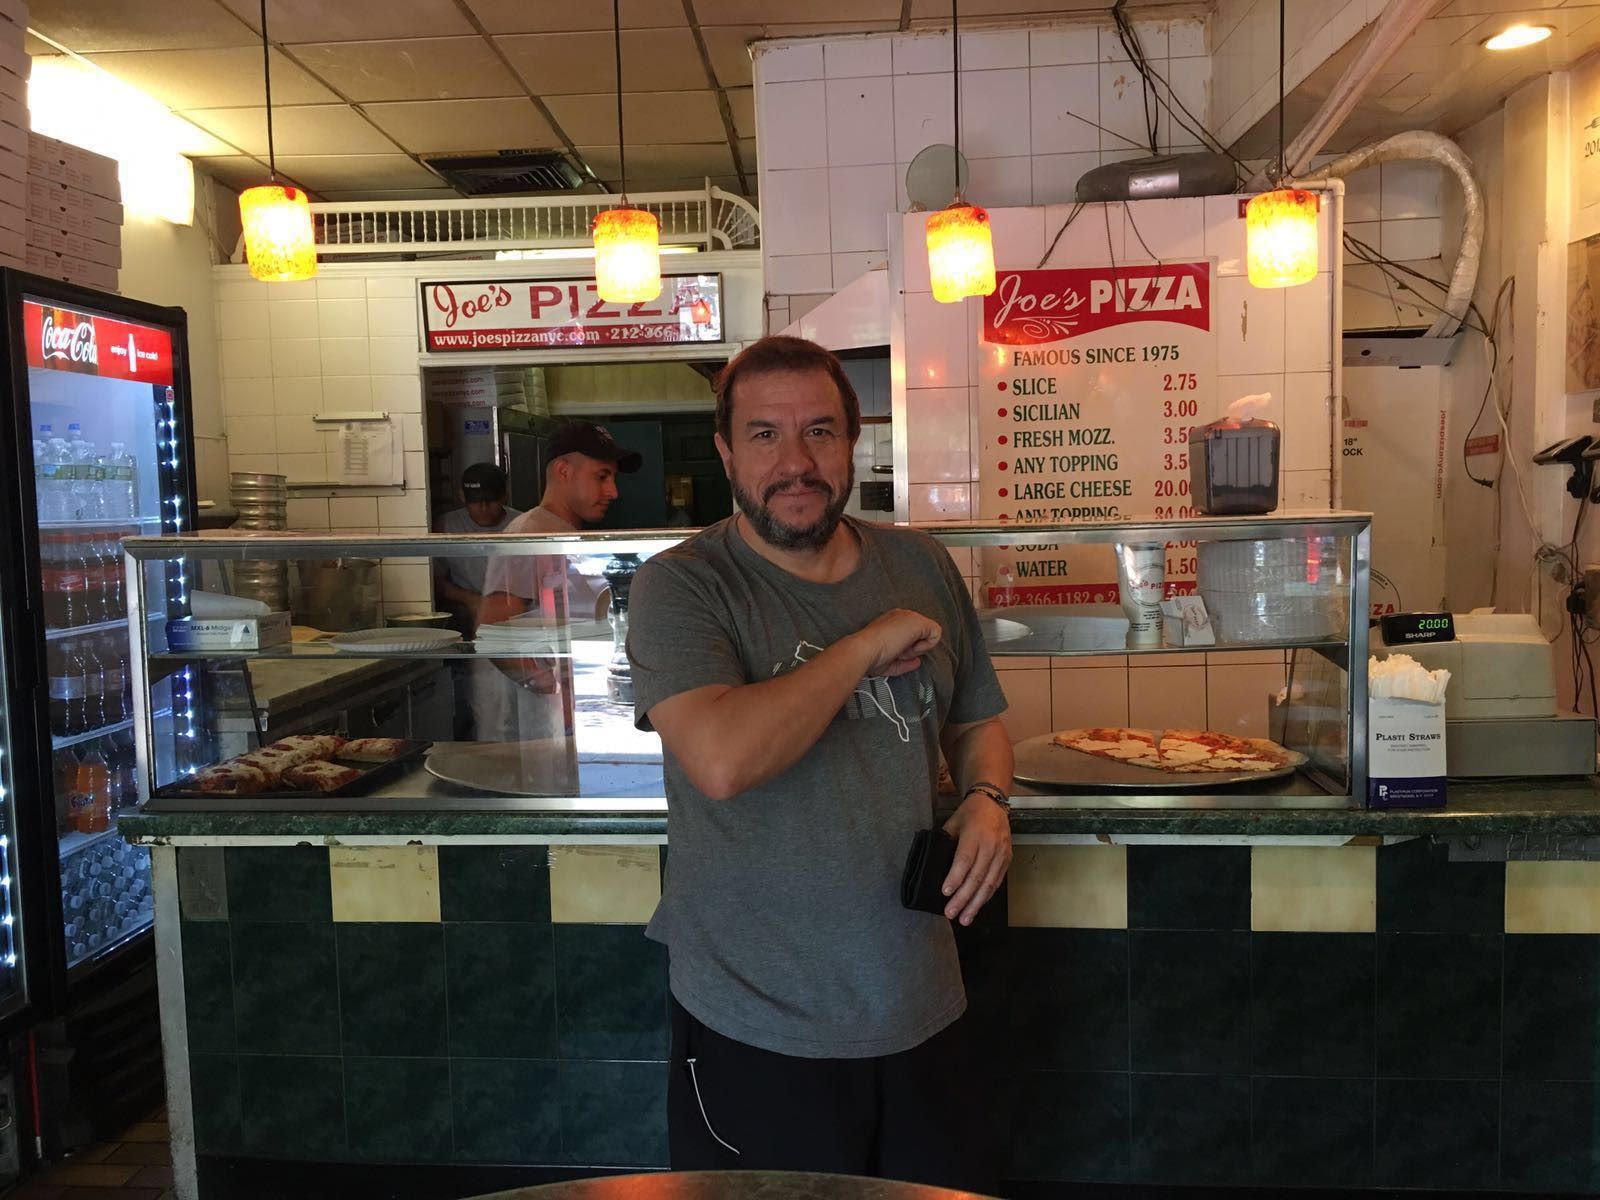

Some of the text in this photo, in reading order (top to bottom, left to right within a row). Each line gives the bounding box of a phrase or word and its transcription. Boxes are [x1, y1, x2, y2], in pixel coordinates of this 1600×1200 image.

[432, 284, 512, 328] Joe's
[993, 275, 1203, 329] Joe's PIZZA
[434, 329, 600, 347] www.joespizzanyc.com
[1013, 345, 1180, 367] FAMOUS SINCE 1975
[1012, 373, 1198, 396] SLICE 2.75
[1012, 400, 1198, 422] SICILIAN 3.00
[1013, 430, 1064, 448] FRESH
[1068, 428, 1116, 446] MOZZ.
[1013, 454, 1189, 474] ANY TOPPING 3.5
[1014, 480, 1192, 501] LARGE CHEESE 20.0
[1015, 558, 1198, 577] WATER 1.50
